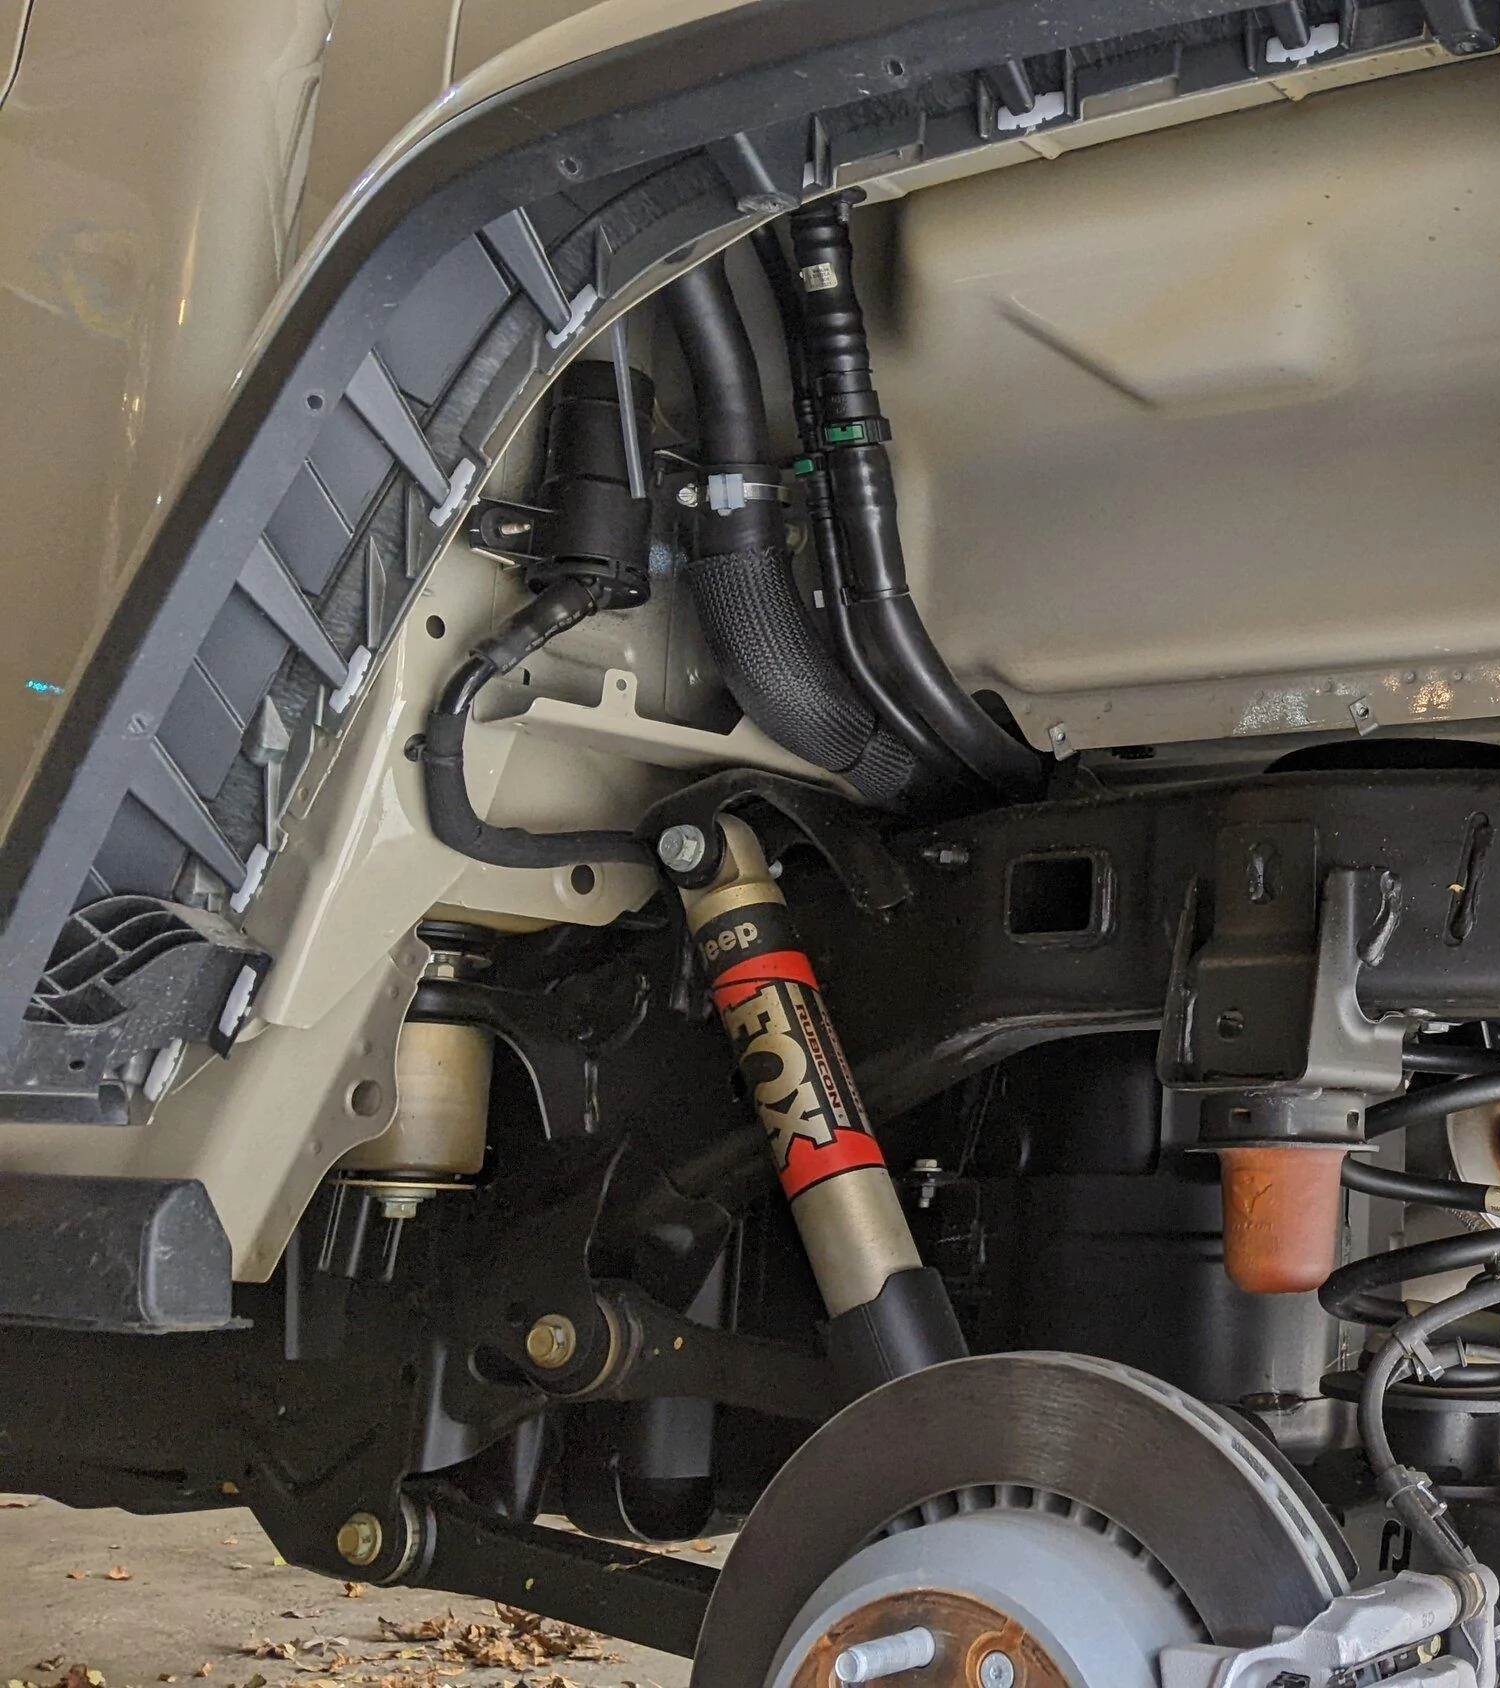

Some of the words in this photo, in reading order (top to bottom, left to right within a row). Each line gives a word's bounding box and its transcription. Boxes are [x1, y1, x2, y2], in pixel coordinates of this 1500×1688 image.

[702, 922, 758, 962] eep
[724, 984, 833, 1169] FOX
[794, 1003, 842, 1109] RUBICON
